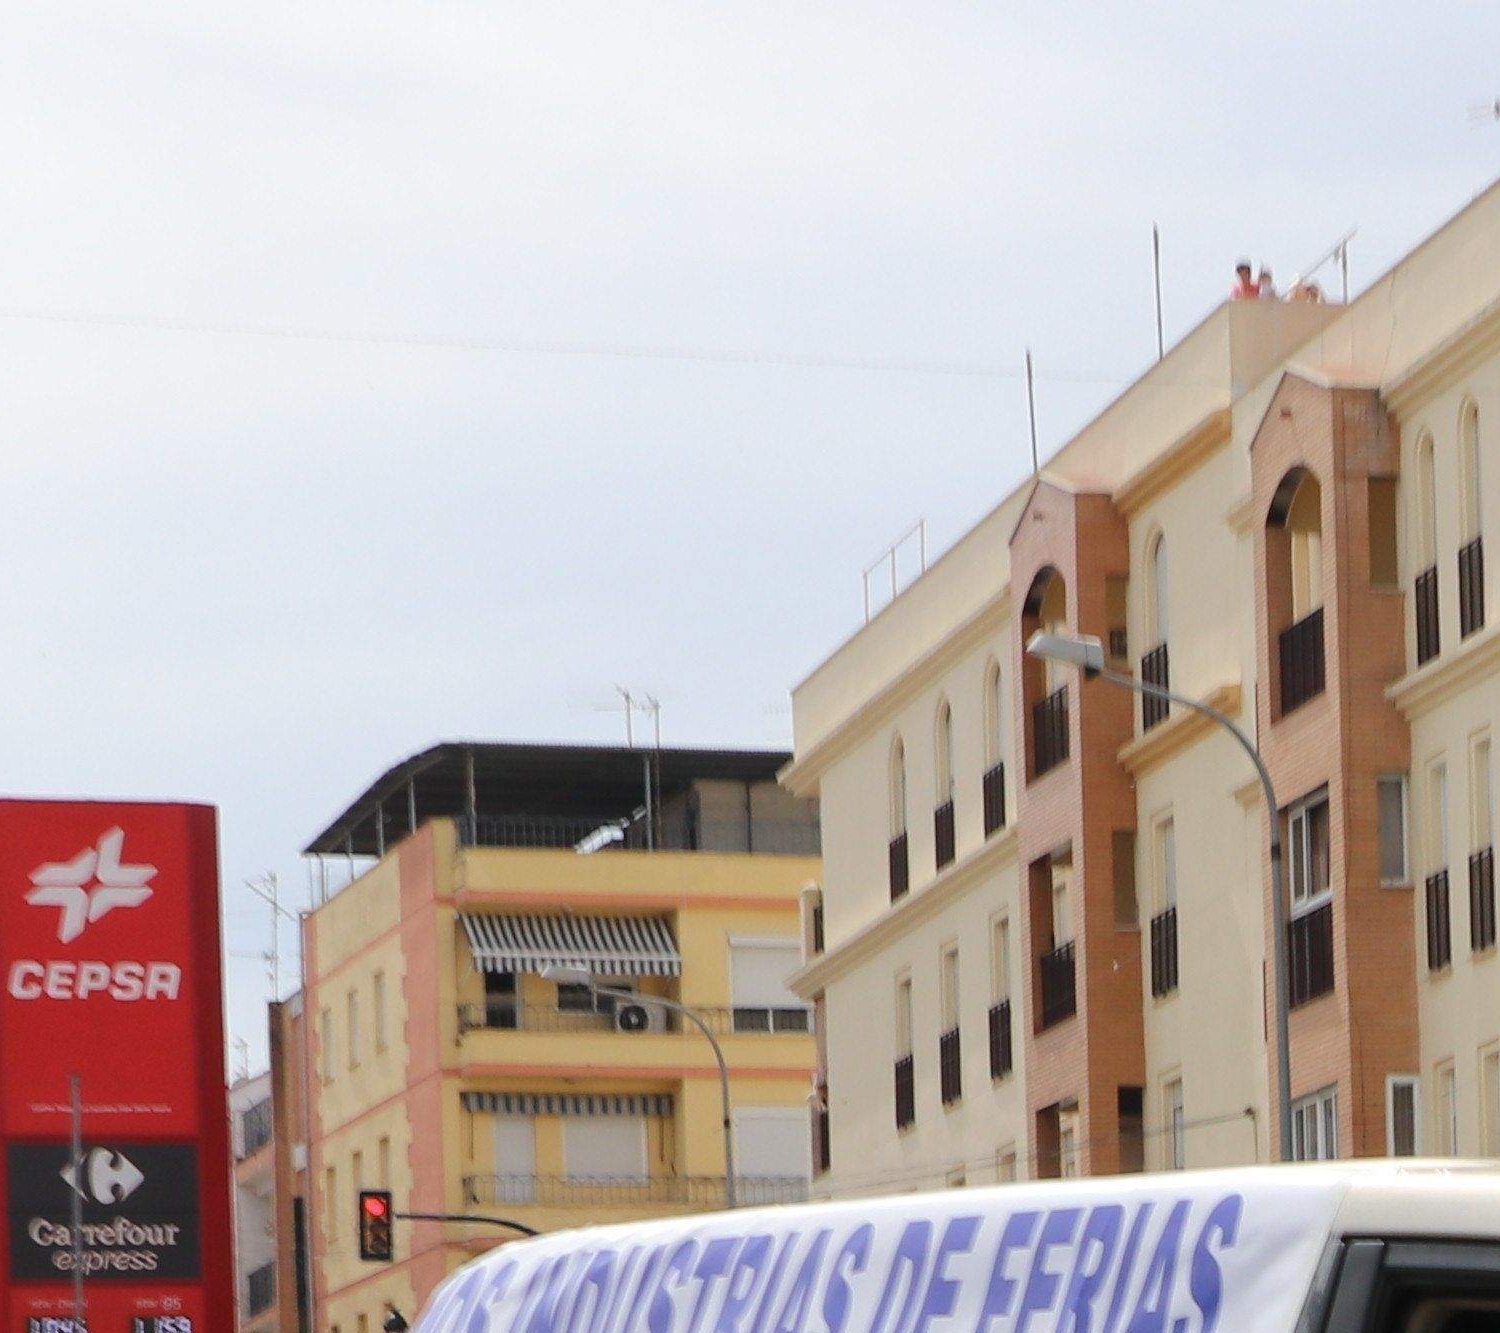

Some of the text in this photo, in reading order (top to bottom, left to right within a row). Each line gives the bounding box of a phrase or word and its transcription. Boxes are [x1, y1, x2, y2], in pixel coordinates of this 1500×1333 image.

[6, 959, 182, 1002] CEPSA
[27, 1215, 181, 1247] Carefour
[52, 1249, 160, 1275] express
